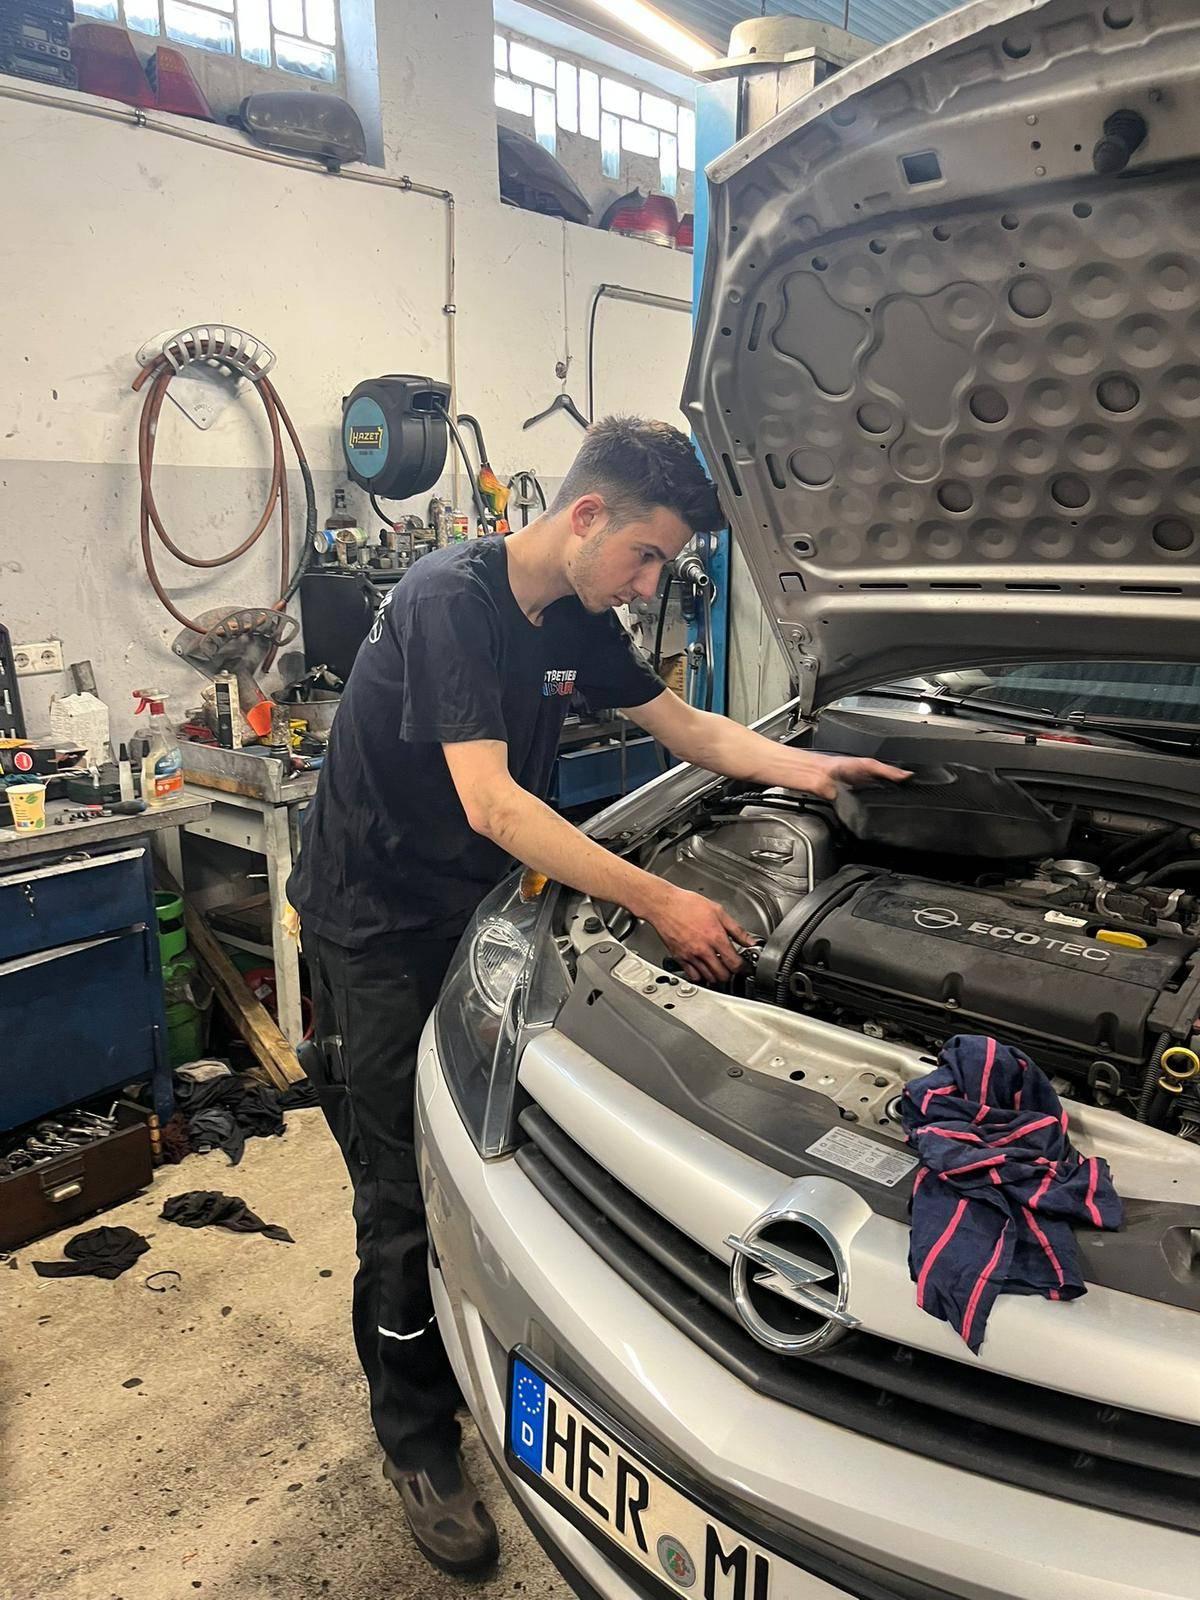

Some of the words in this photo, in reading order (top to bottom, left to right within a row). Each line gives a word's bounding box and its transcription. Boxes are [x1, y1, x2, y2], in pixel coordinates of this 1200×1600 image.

[352, 432, 380, 444] HAZET
[967, 921, 1111, 961] ECOTEC
[521, 1421, 534, 1447] D
[545, 1397, 649, 1554] HER
